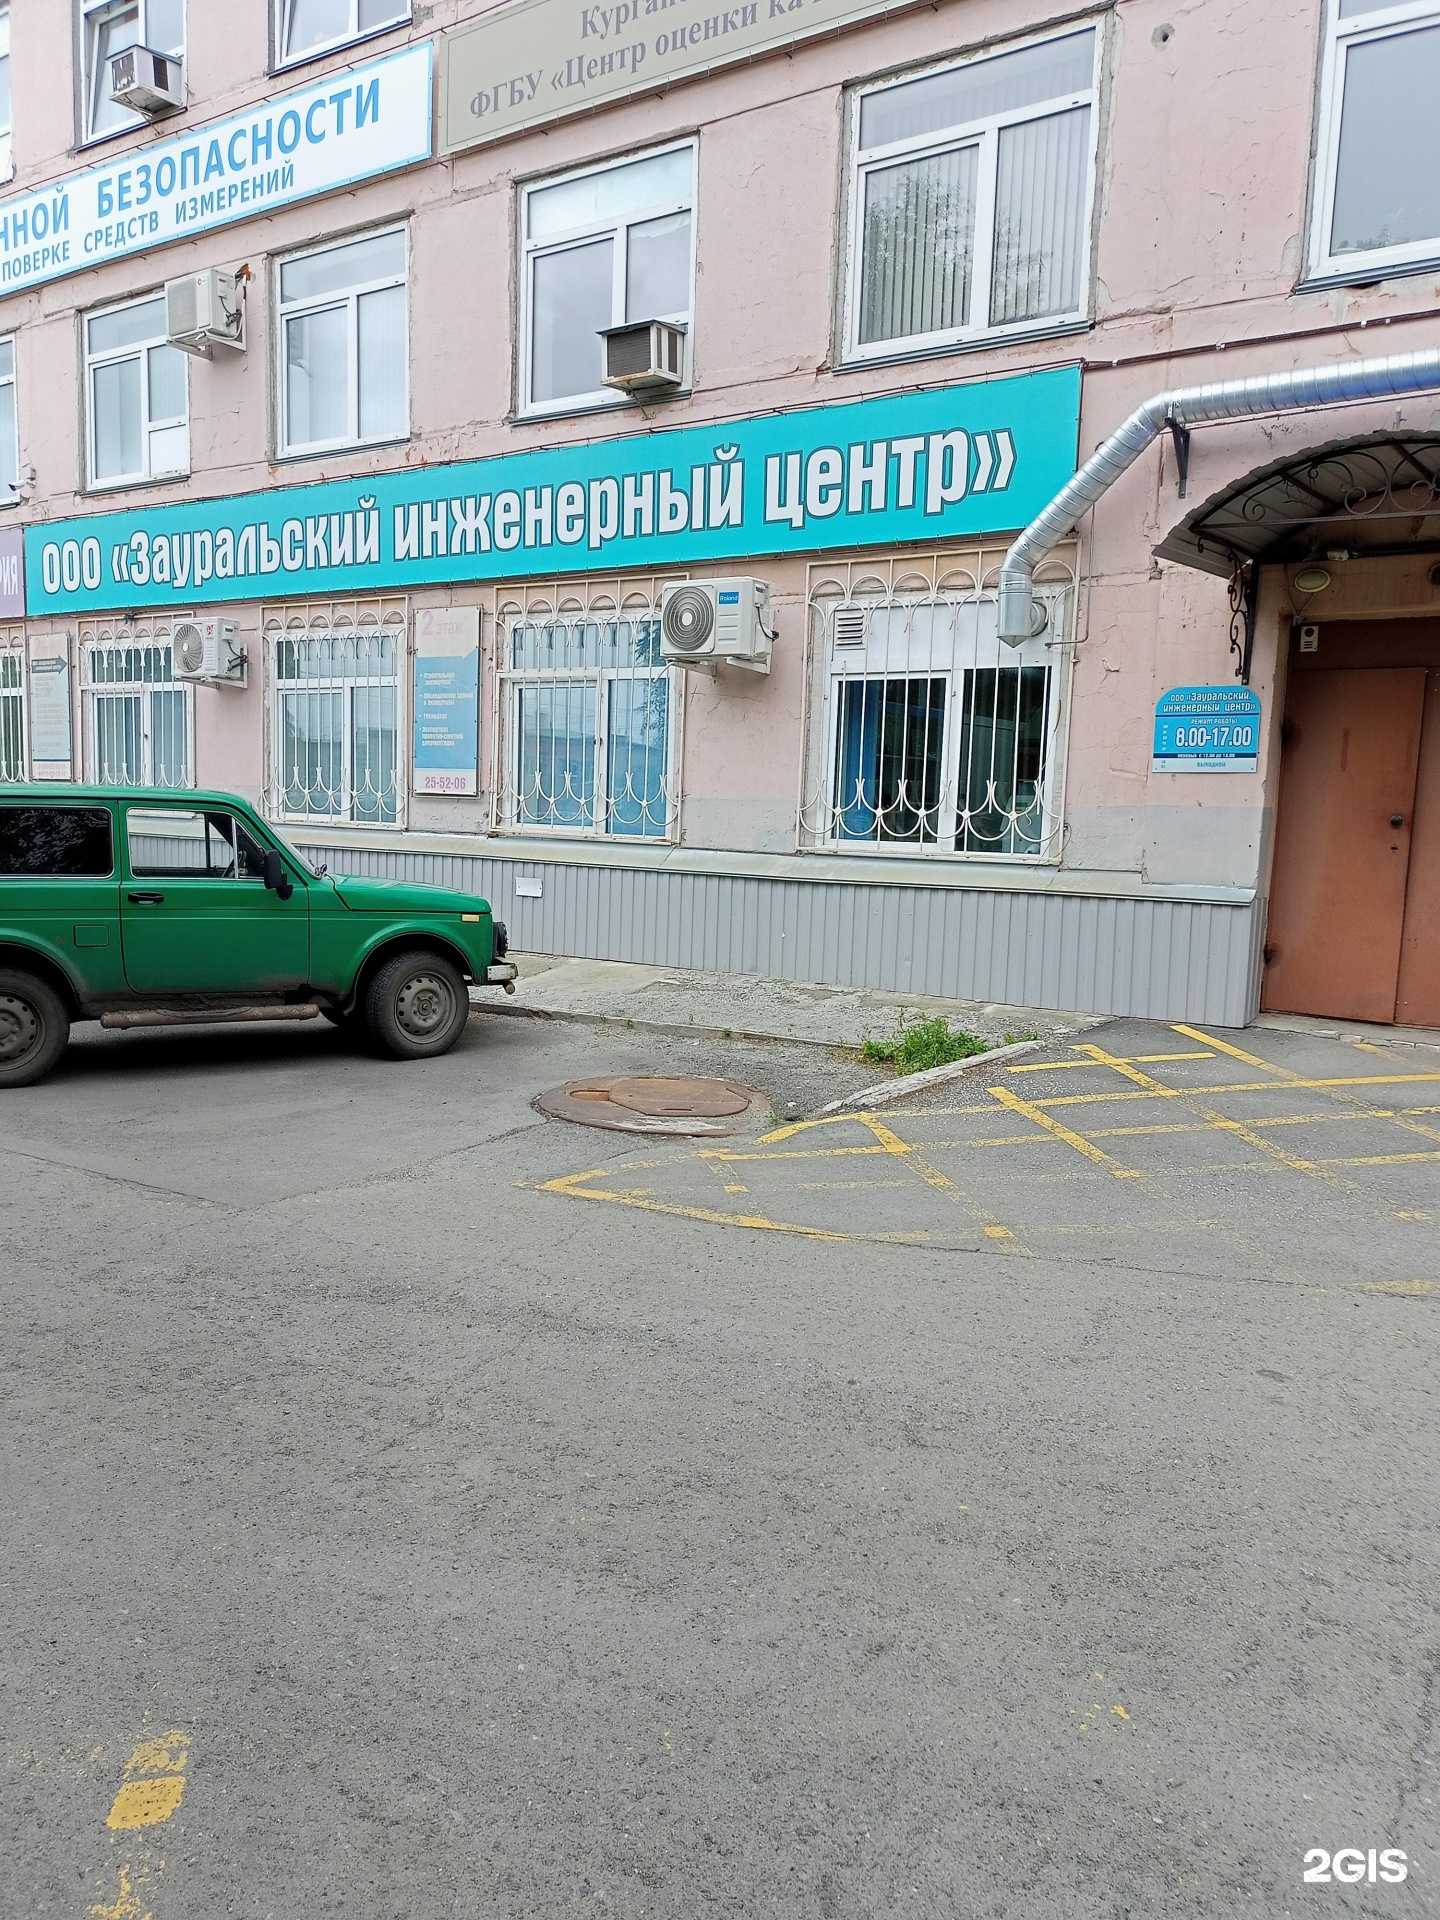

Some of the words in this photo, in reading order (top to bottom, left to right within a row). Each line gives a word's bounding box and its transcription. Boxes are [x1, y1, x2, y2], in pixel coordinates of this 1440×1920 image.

[469, 70, 544, 119] ФГБУ
[550, 41, 647, 91] «Центр
[655, 3, 758, 56] оценки
[97, 78, 381, 218] БЕЗОПАСНОСТИ
[2, 240, 70, 282] ПОВЕРКЕ
[84, 210, 160, 253] СРЕДСТВ
[175, 161, 294, 225] ИЗМЕРЕНИЙ
[42, 536, 102, 595] ООО
[110, 494, 381, 588] «Зауральский
[393, 443, 745, 562] инженерный
[763, 426, 1017, 530] центр»
[1176, 727, 1252, 747] 8.00-17.00
